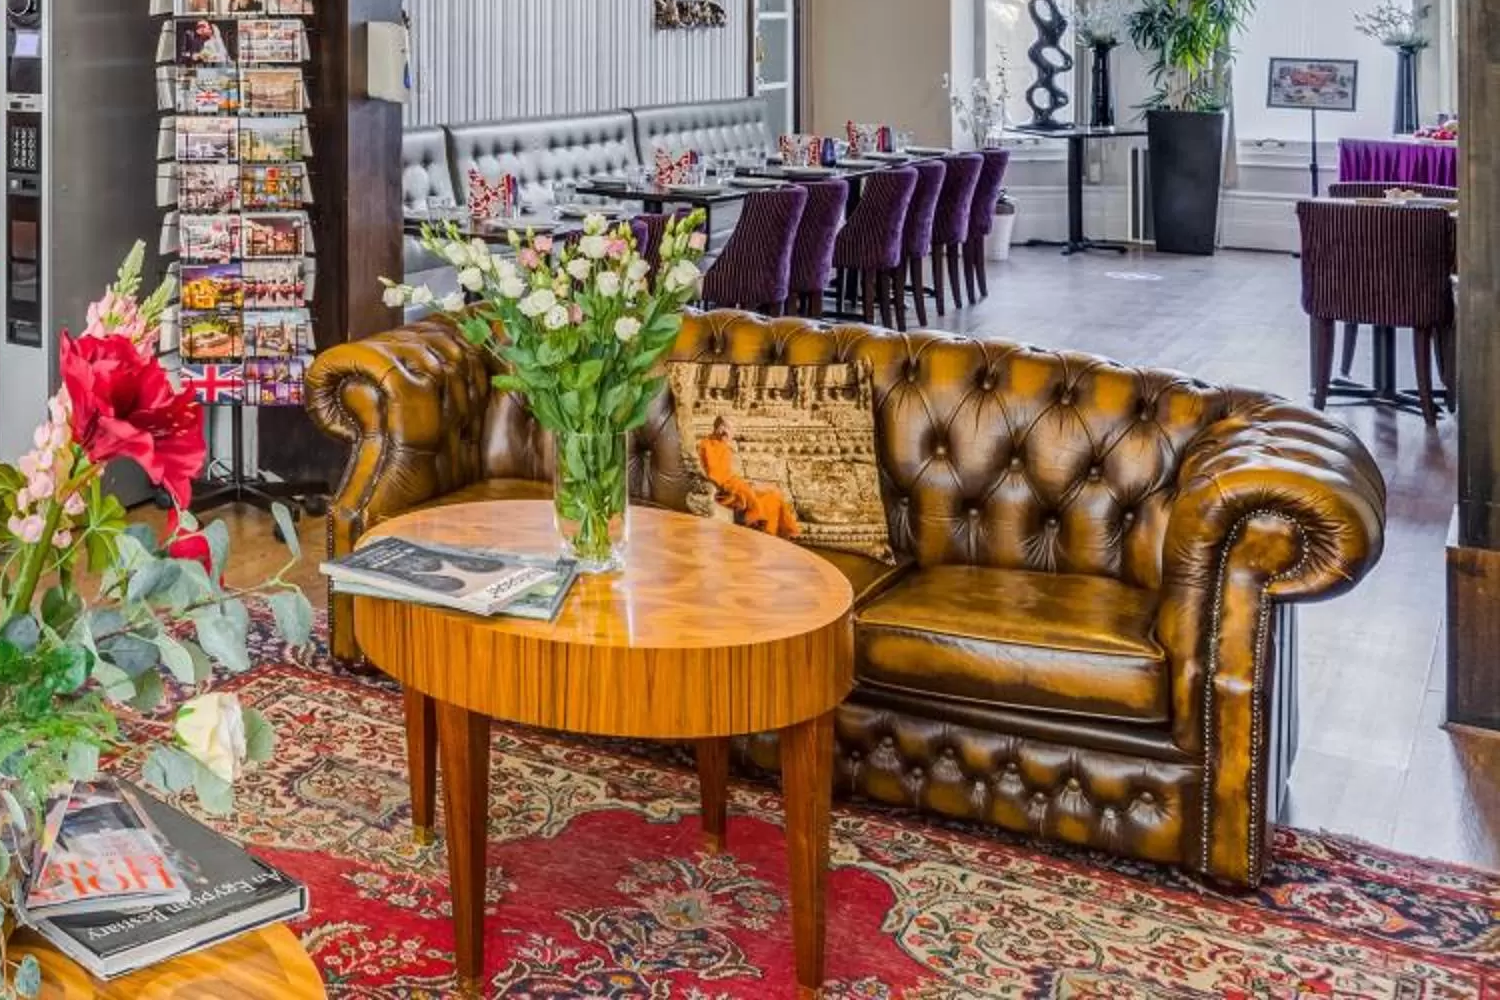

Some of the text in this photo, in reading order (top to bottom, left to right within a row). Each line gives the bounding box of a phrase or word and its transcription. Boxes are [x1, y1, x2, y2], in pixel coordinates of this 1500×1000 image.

[87, 869, 283, 941] An Egyptian Bestiary
